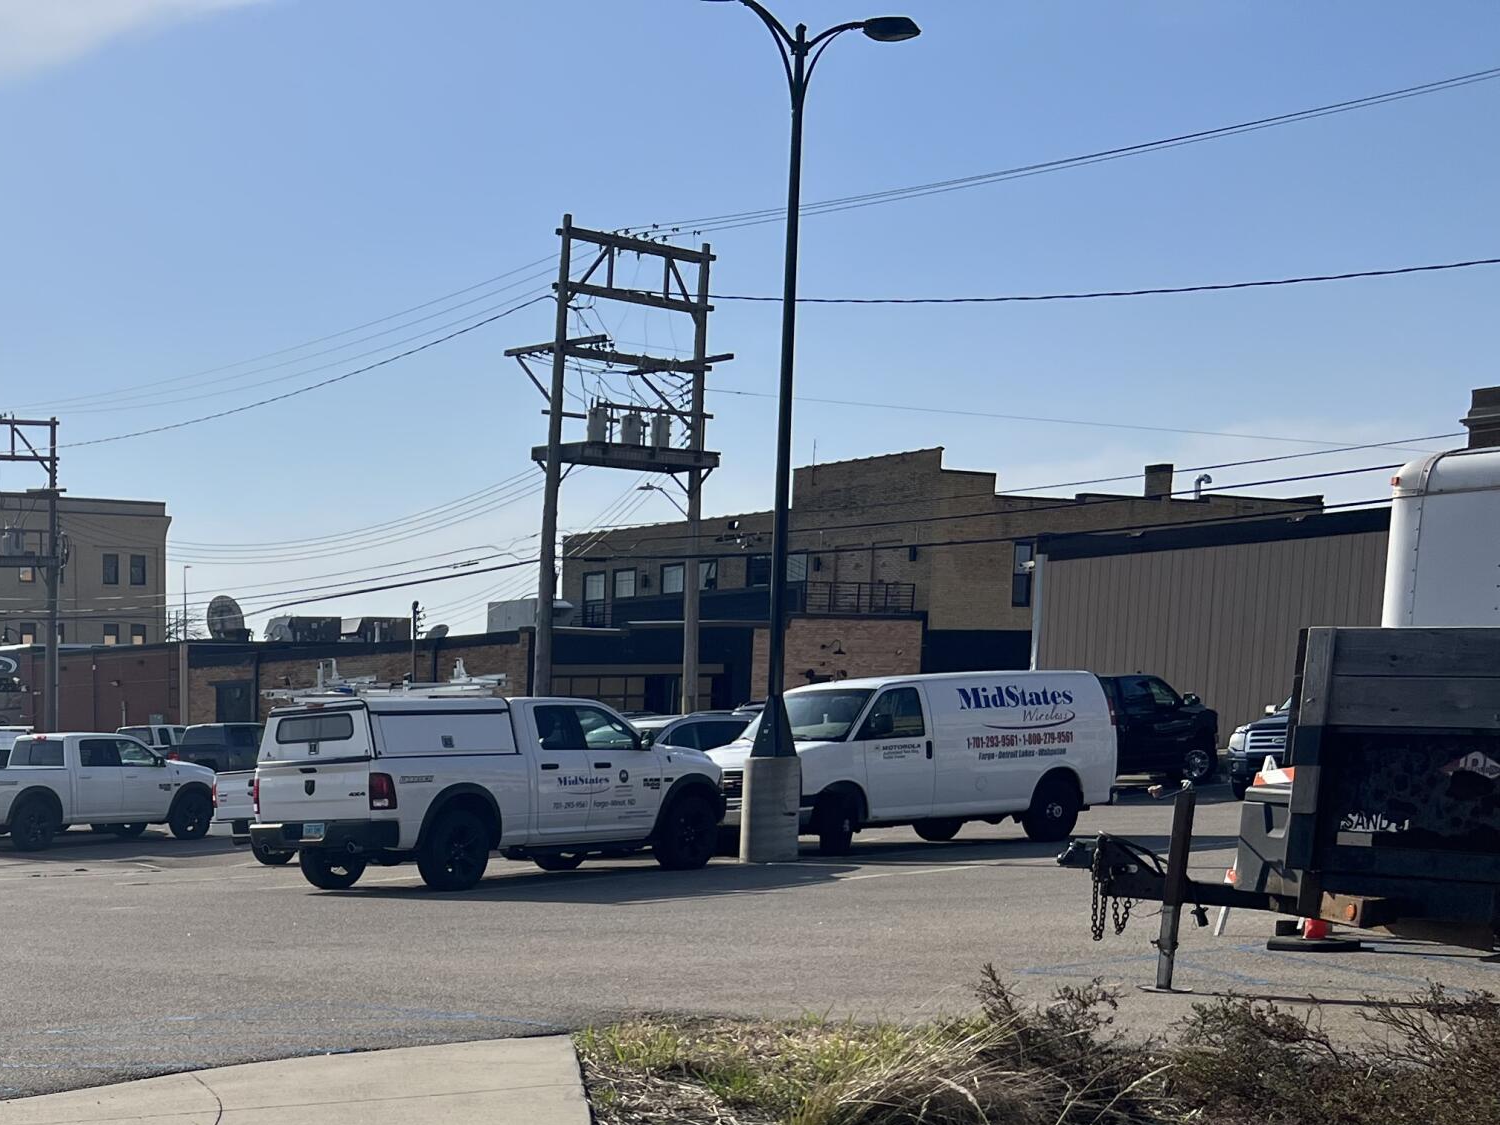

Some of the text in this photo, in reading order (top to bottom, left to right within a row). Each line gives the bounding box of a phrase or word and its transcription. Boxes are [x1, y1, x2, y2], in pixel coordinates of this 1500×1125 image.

[956, 685, 1074, 710] MidStates
[1022, 704, 1069, 722] Wireless
[967, 731, 1074, 749] 1-701-293-9561 1-800-279-9561
[557, 776, 610, 786] MidStates
